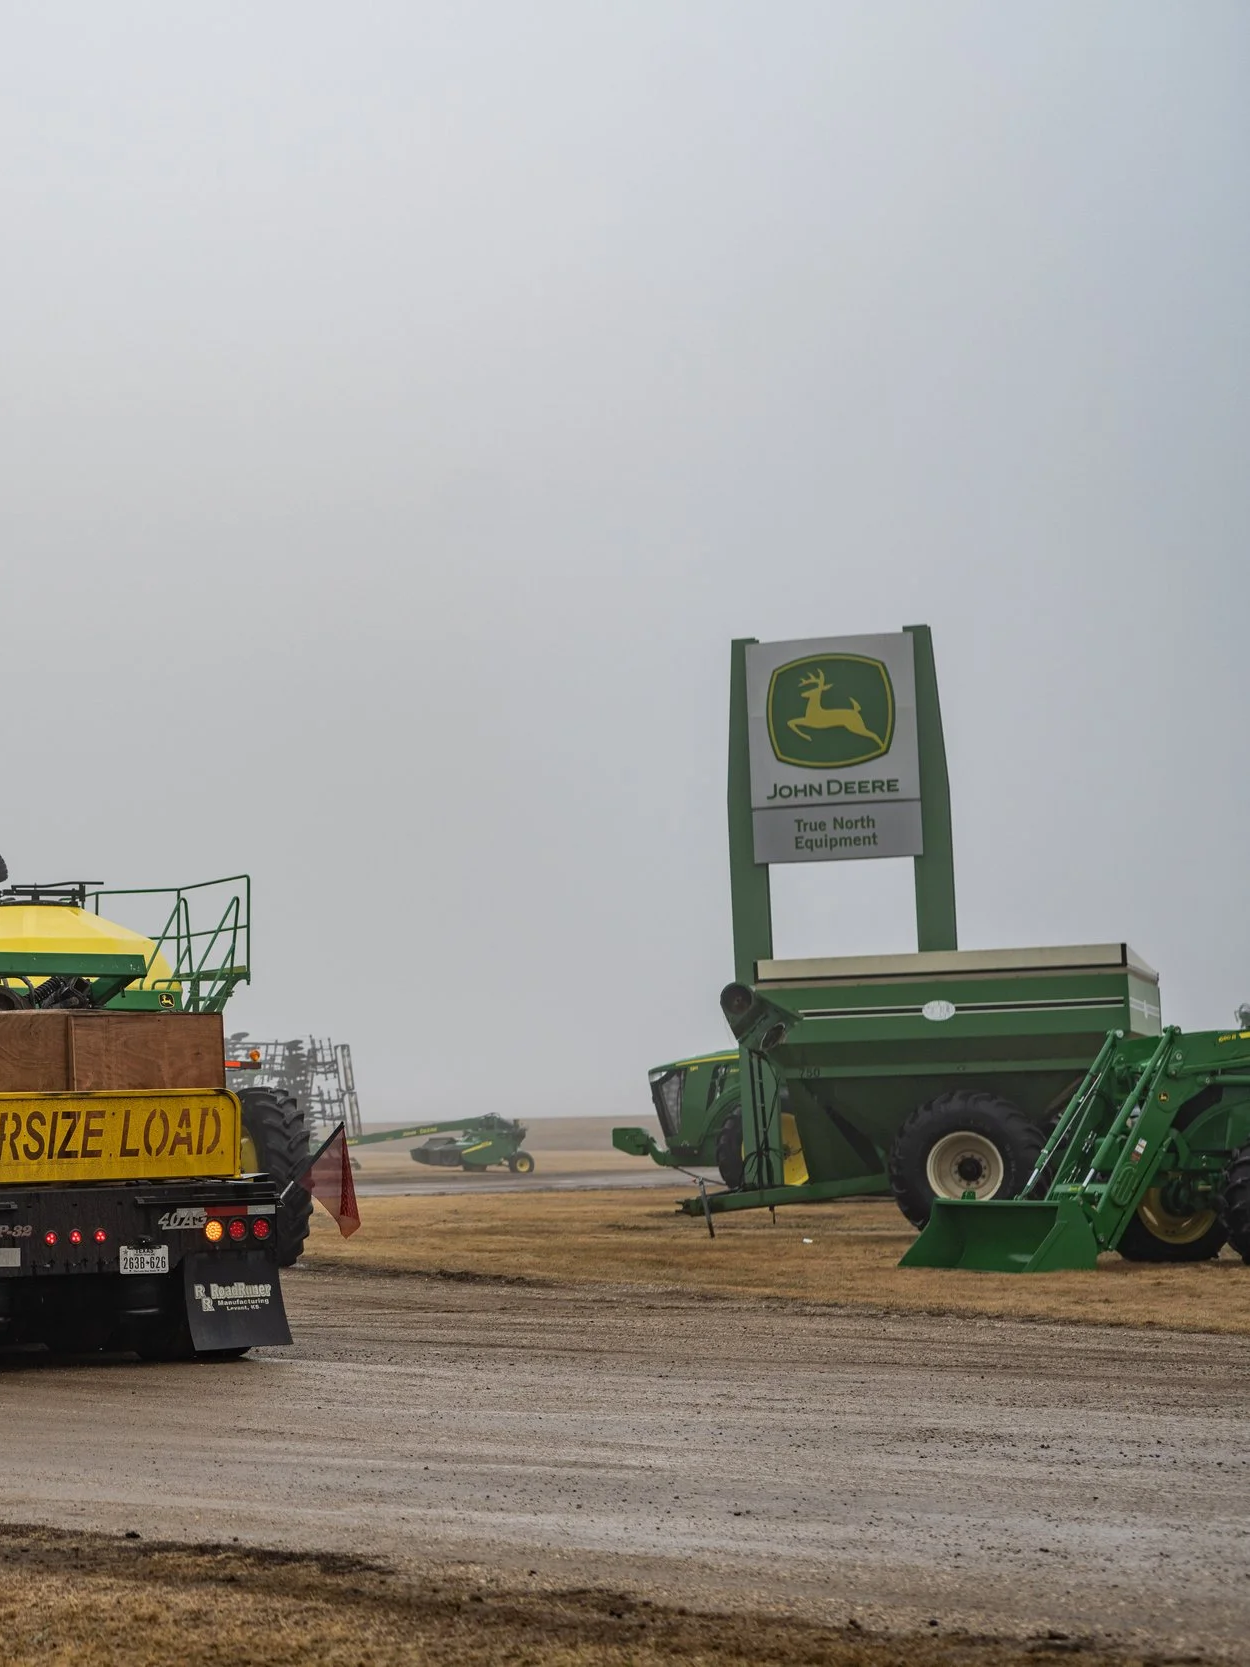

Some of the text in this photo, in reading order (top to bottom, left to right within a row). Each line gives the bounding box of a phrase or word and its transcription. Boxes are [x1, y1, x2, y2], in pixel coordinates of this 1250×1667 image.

[767, 779, 900, 800] JOHN DEERE
[794, 815, 876, 833] True North
[794, 832, 878, 852] Equipment
[119, 1107, 222, 1157] LOAD
[217, 1298, 270, 1306] Manufacturing
